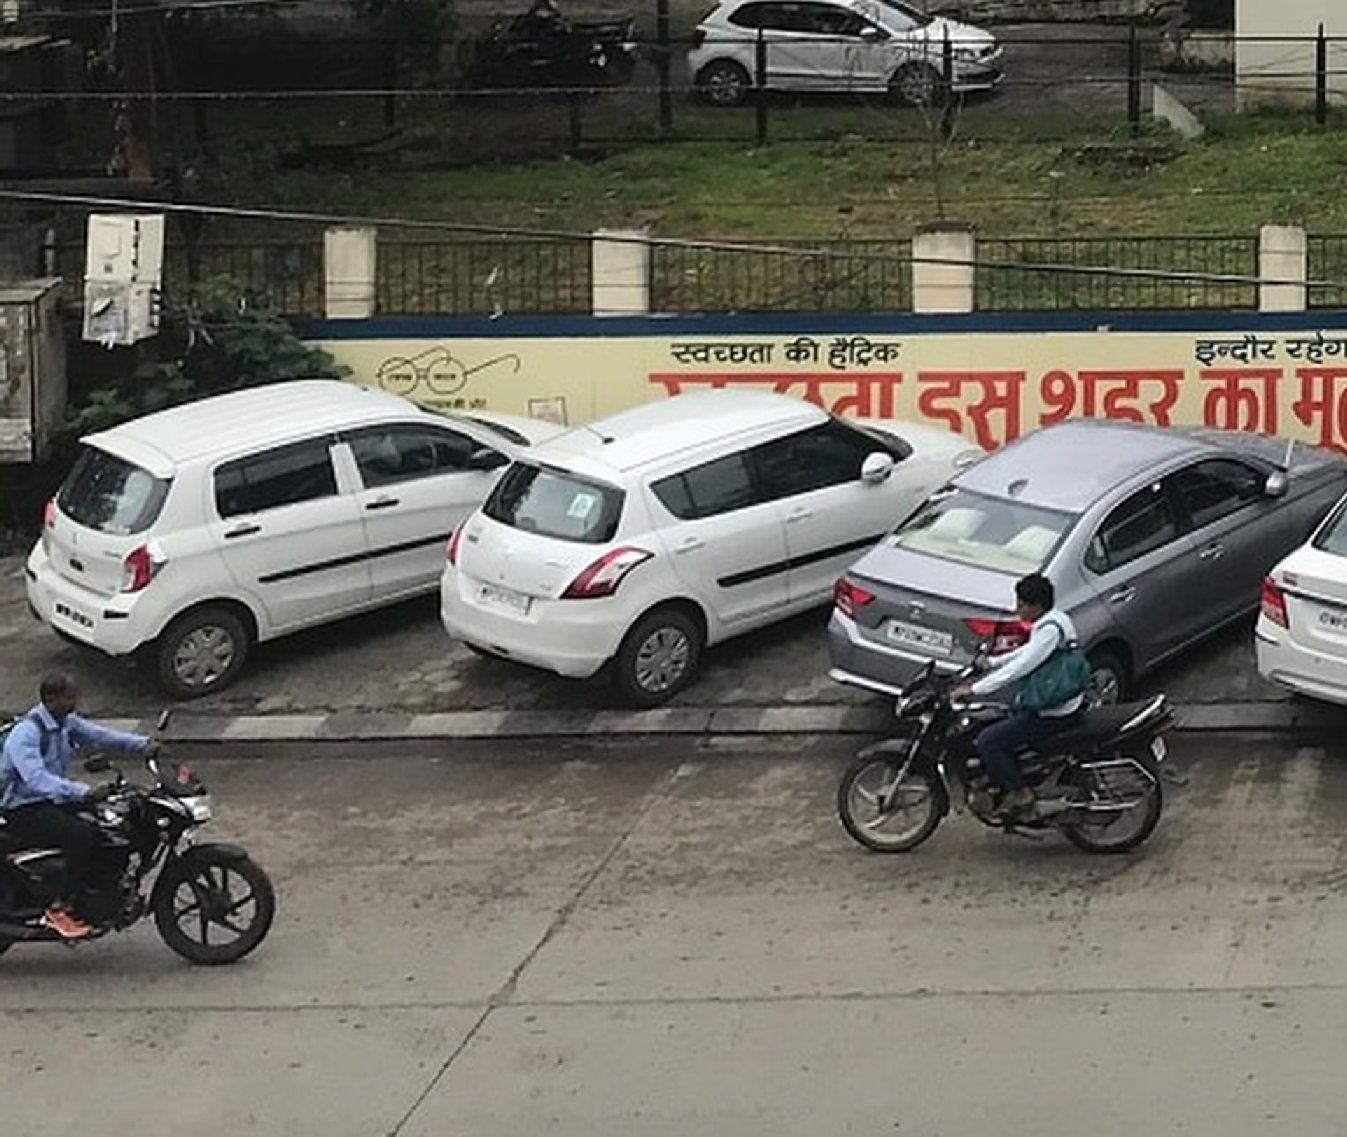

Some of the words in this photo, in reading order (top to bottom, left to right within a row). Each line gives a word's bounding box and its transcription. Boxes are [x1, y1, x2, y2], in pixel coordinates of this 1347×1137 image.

[671, 342, 774, 364] स्वच्छता
[784, 338, 820, 363] की
[1195, 335, 1276, 366] इन्दौर
